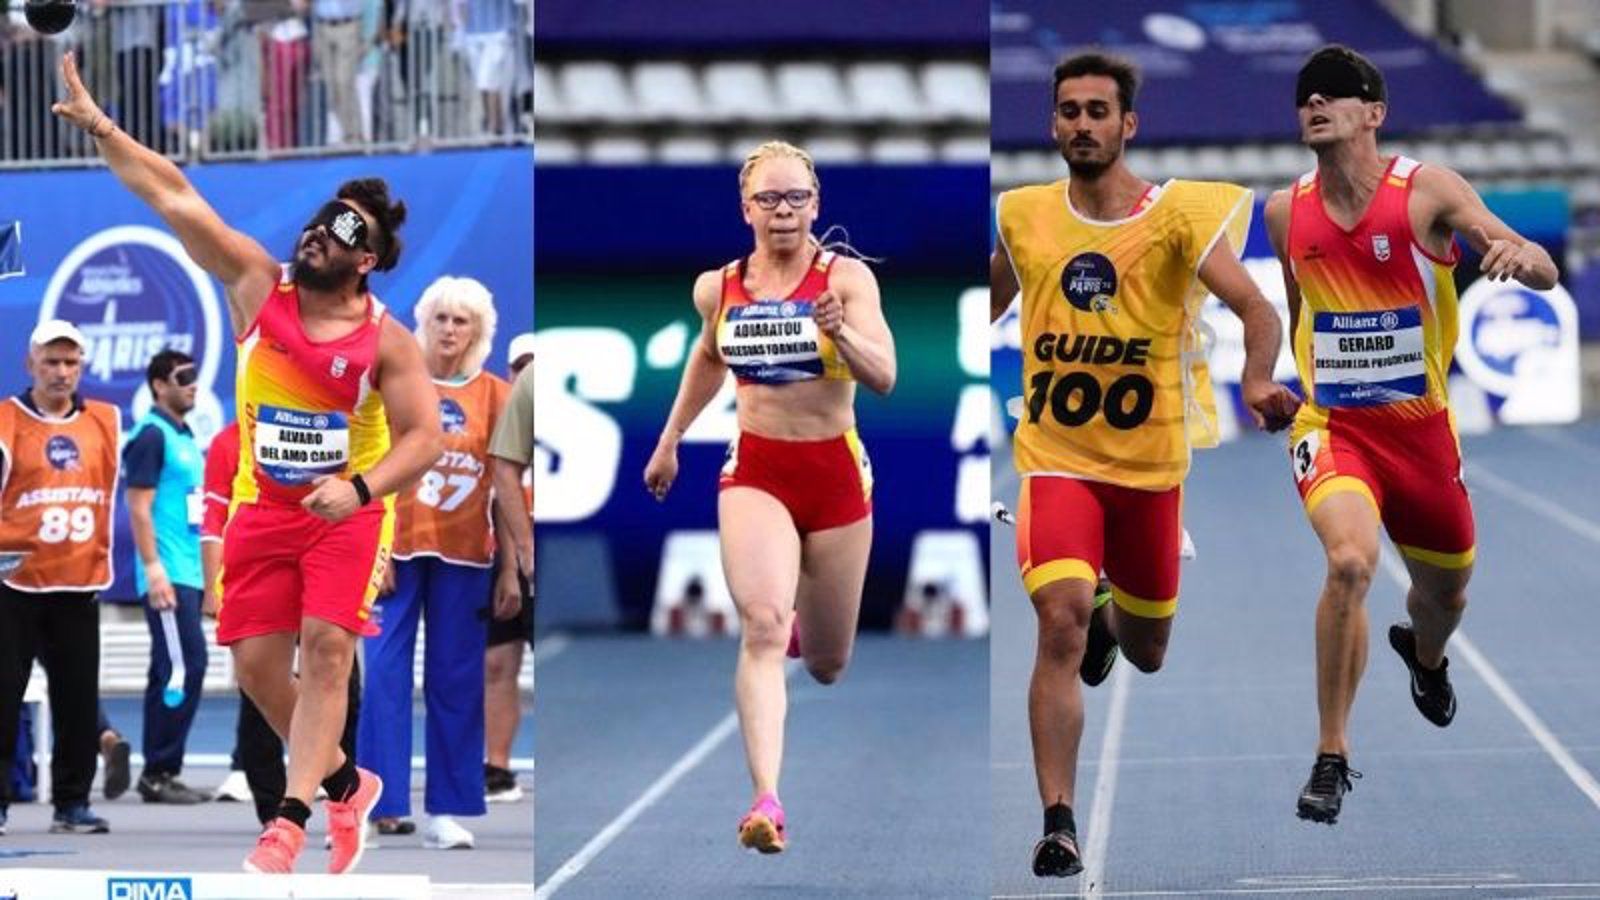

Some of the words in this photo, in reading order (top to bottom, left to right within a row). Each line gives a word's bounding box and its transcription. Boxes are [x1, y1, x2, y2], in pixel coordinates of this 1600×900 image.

[1332, 316, 1378, 329] Allianz
[1034, 333, 1151, 365] GUIDE
[1339, 335, 1395, 353] GERARD
[1028, 370, 1155, 430] 100
[279, 430, 322, 444] ALVARO
[282, 448, 308, 463] AMO
[1296, 439, 1312, 475] 3
[417, 471, 477, 511] 87
[39, 506, 95, 543] 89
[111, 882, 188, 900] DIMA
